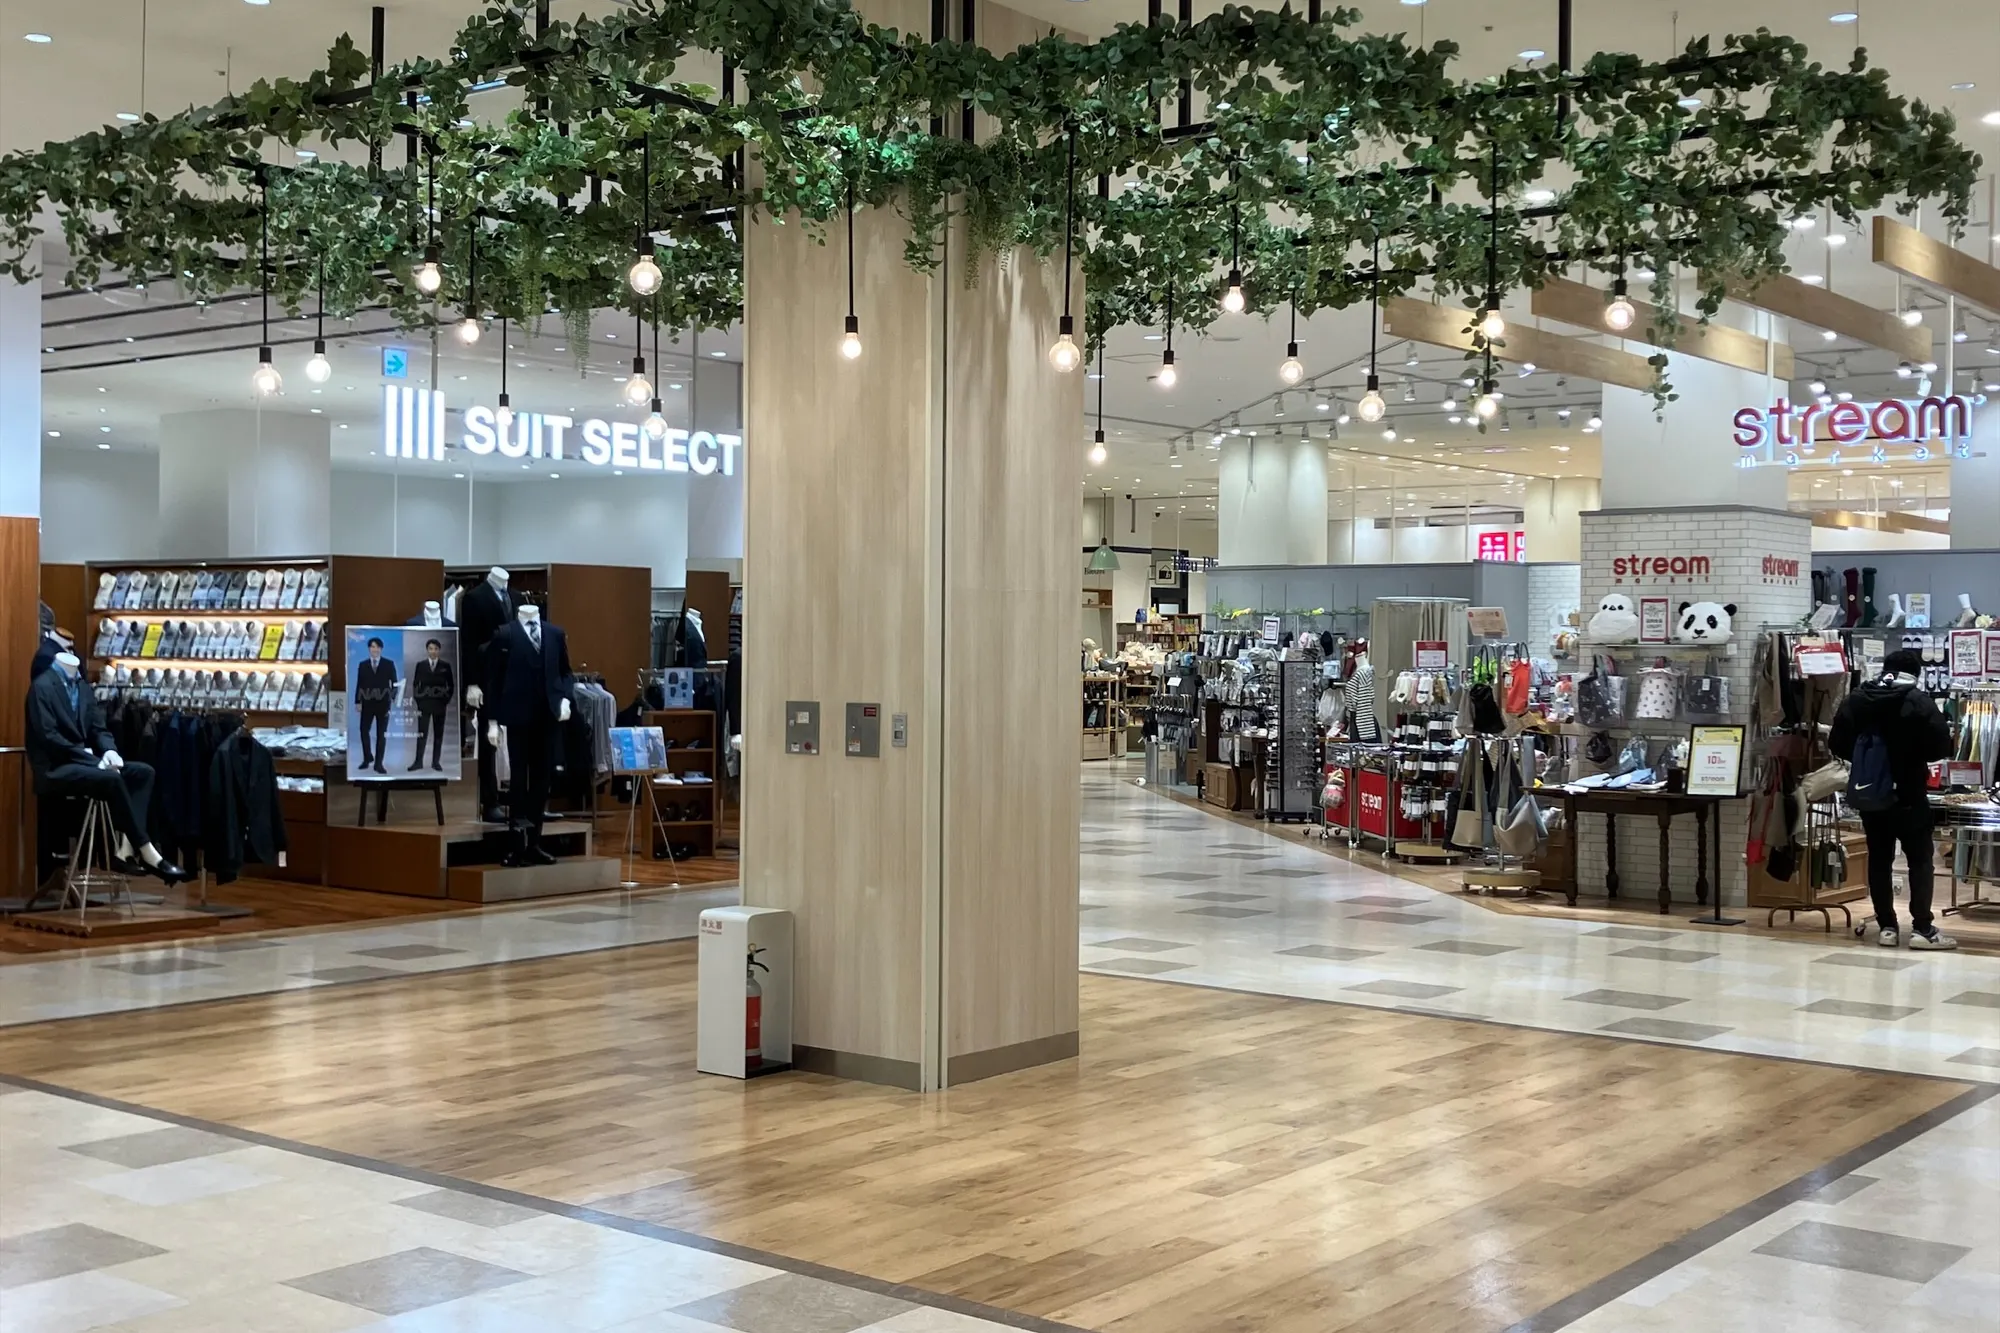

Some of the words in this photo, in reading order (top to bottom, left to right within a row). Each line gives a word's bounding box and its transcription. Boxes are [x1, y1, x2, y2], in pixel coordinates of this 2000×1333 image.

[1734, 395, 1974, 447] stream
[463, 405, 573, 460] SUIT
[581, 418, 742, 476] SELECT
[1738, 442, 1970, 468] market
[1613, 554, 1710, 575] stream
[1762, 553, 1799, 577] stream
[1615, 575, 1709, 584] market
